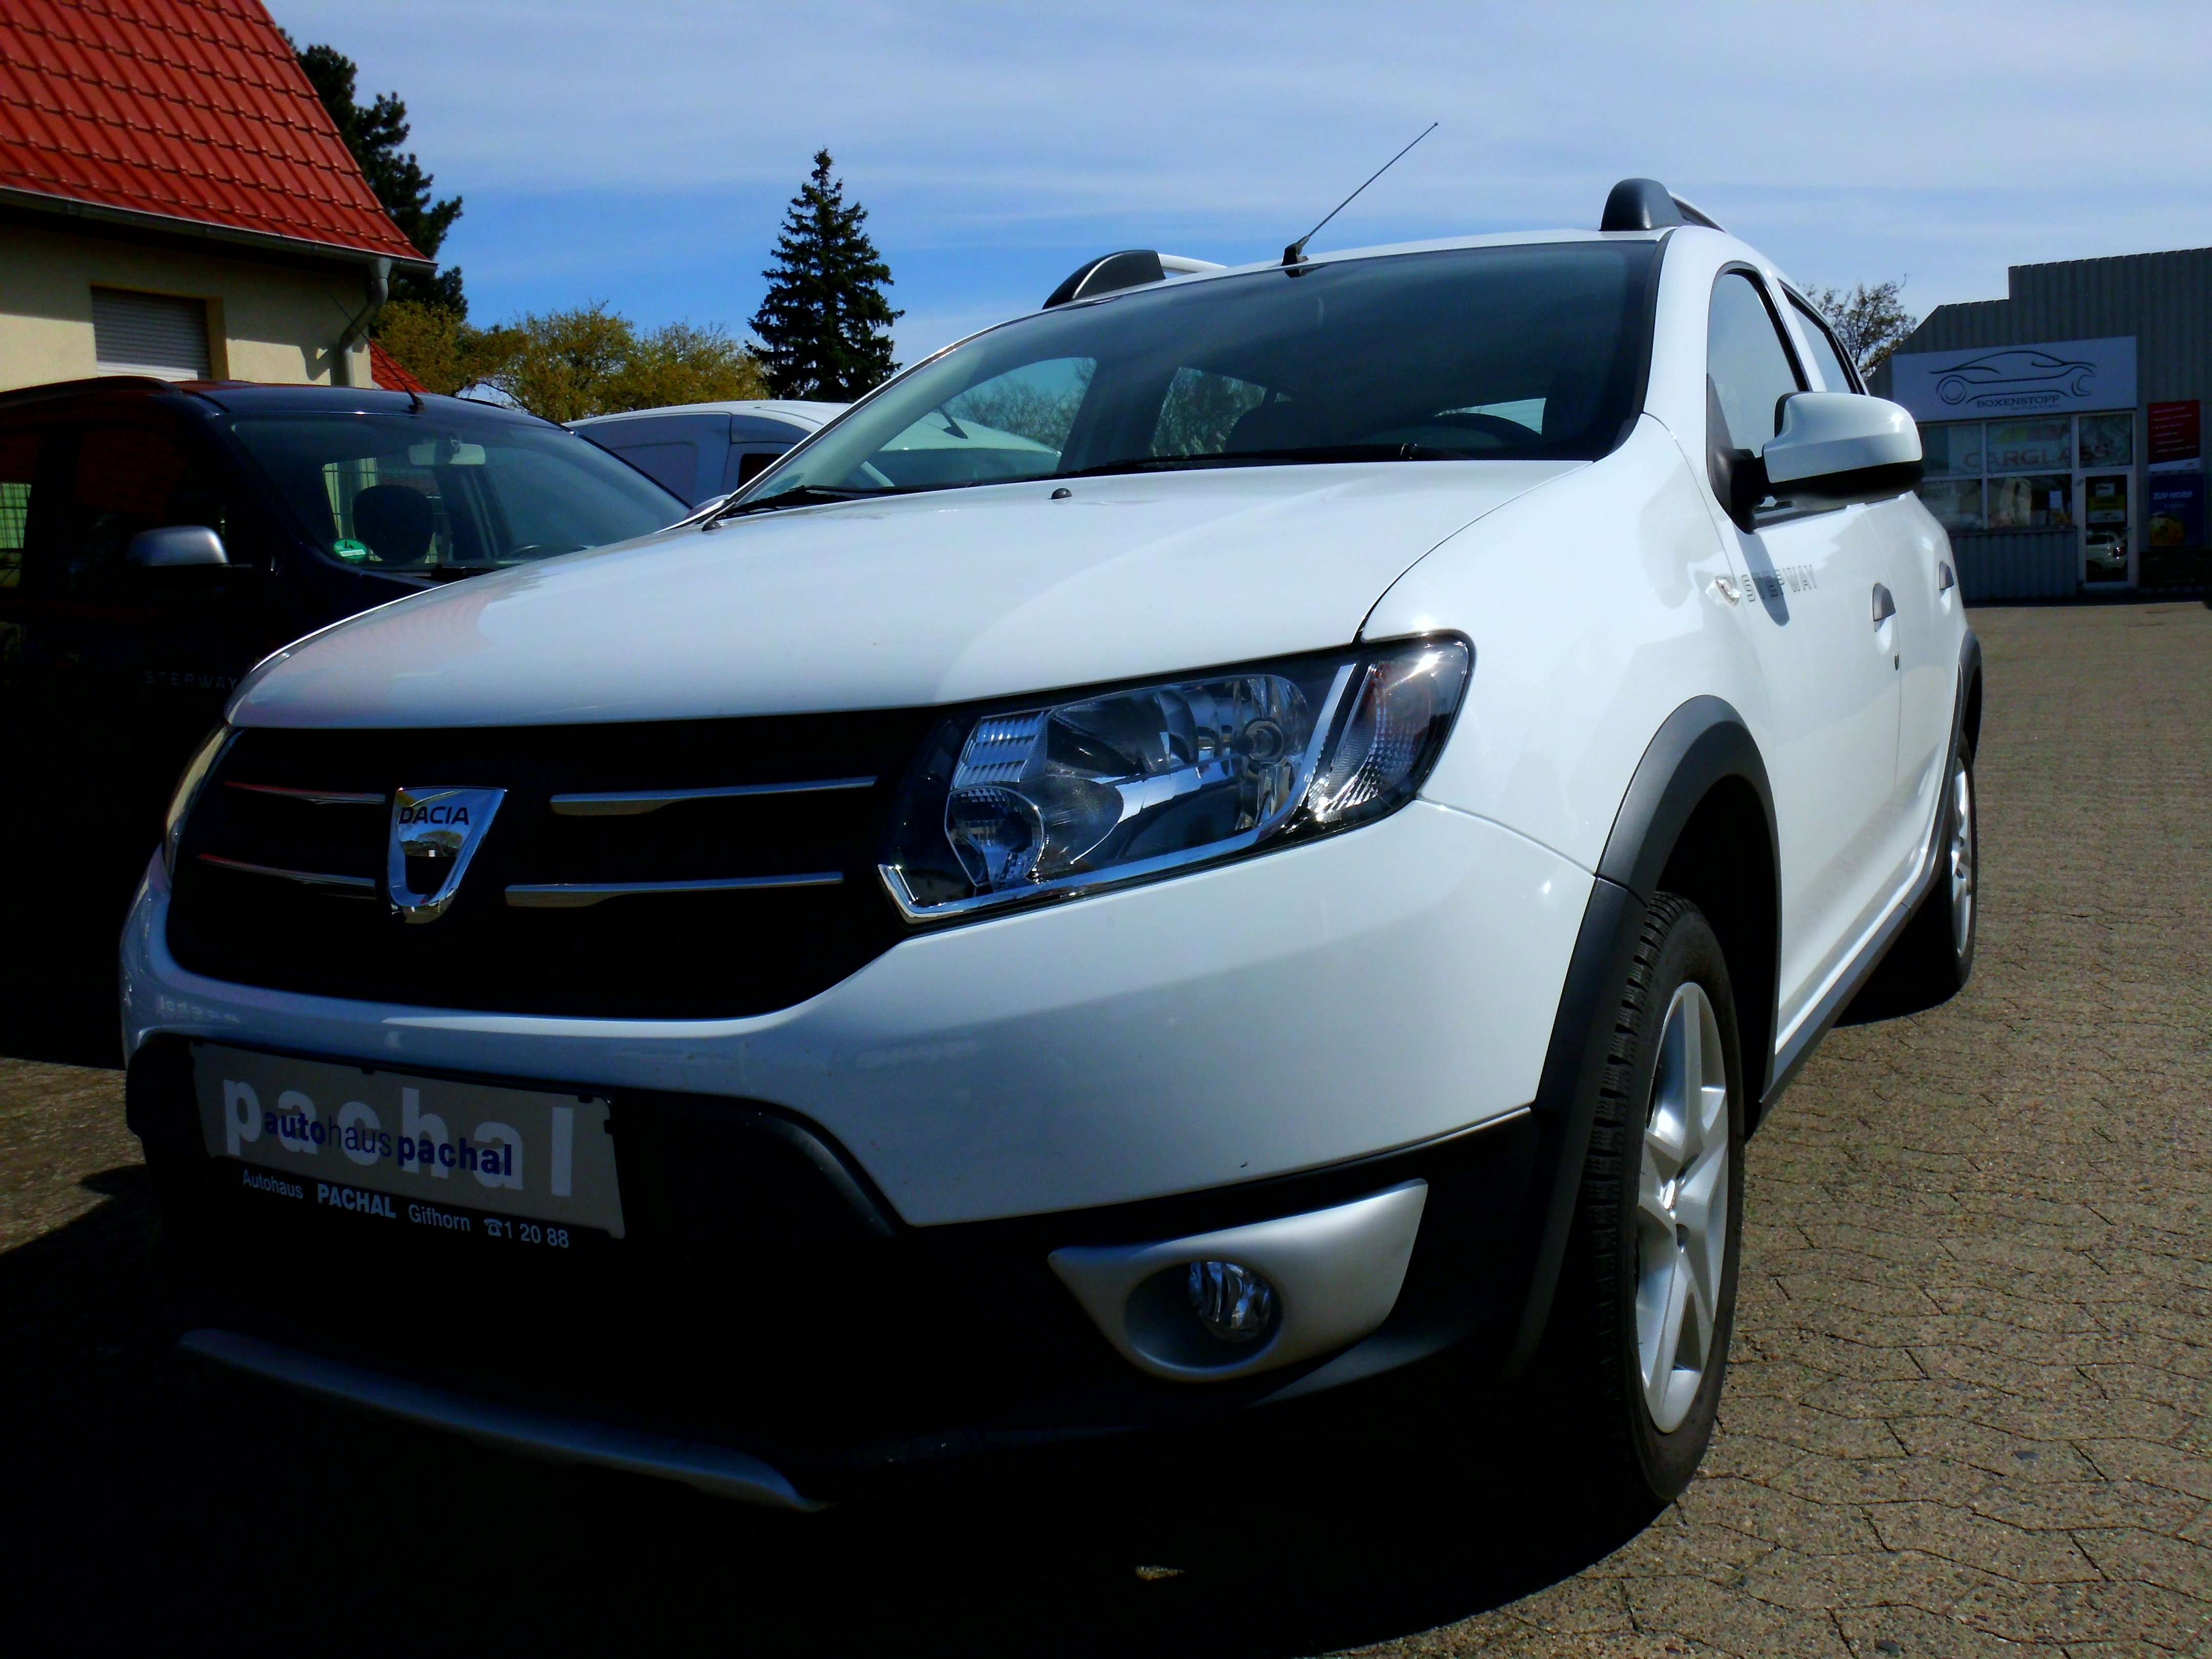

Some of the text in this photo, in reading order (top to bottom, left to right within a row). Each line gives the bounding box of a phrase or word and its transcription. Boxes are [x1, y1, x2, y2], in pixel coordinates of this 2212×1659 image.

[1976, 395, 2059, 408] BOXENSTOPP
[345, 541, 354, 549] 4
[143, 671, 238, 689] STEPWAY
[399, 806, 469, 825] DACIA
[264, 1111, 512, 1176] autohaus pachal
[242, 1168, 304, 1200] Autohaus
[316, 1183, 397, 1219] PACHAL
[408, 1203, 472, 1231] Gifhorn
[520, 1223, 542, 1244] 20
[546, 1227, 570, 1248] 88
